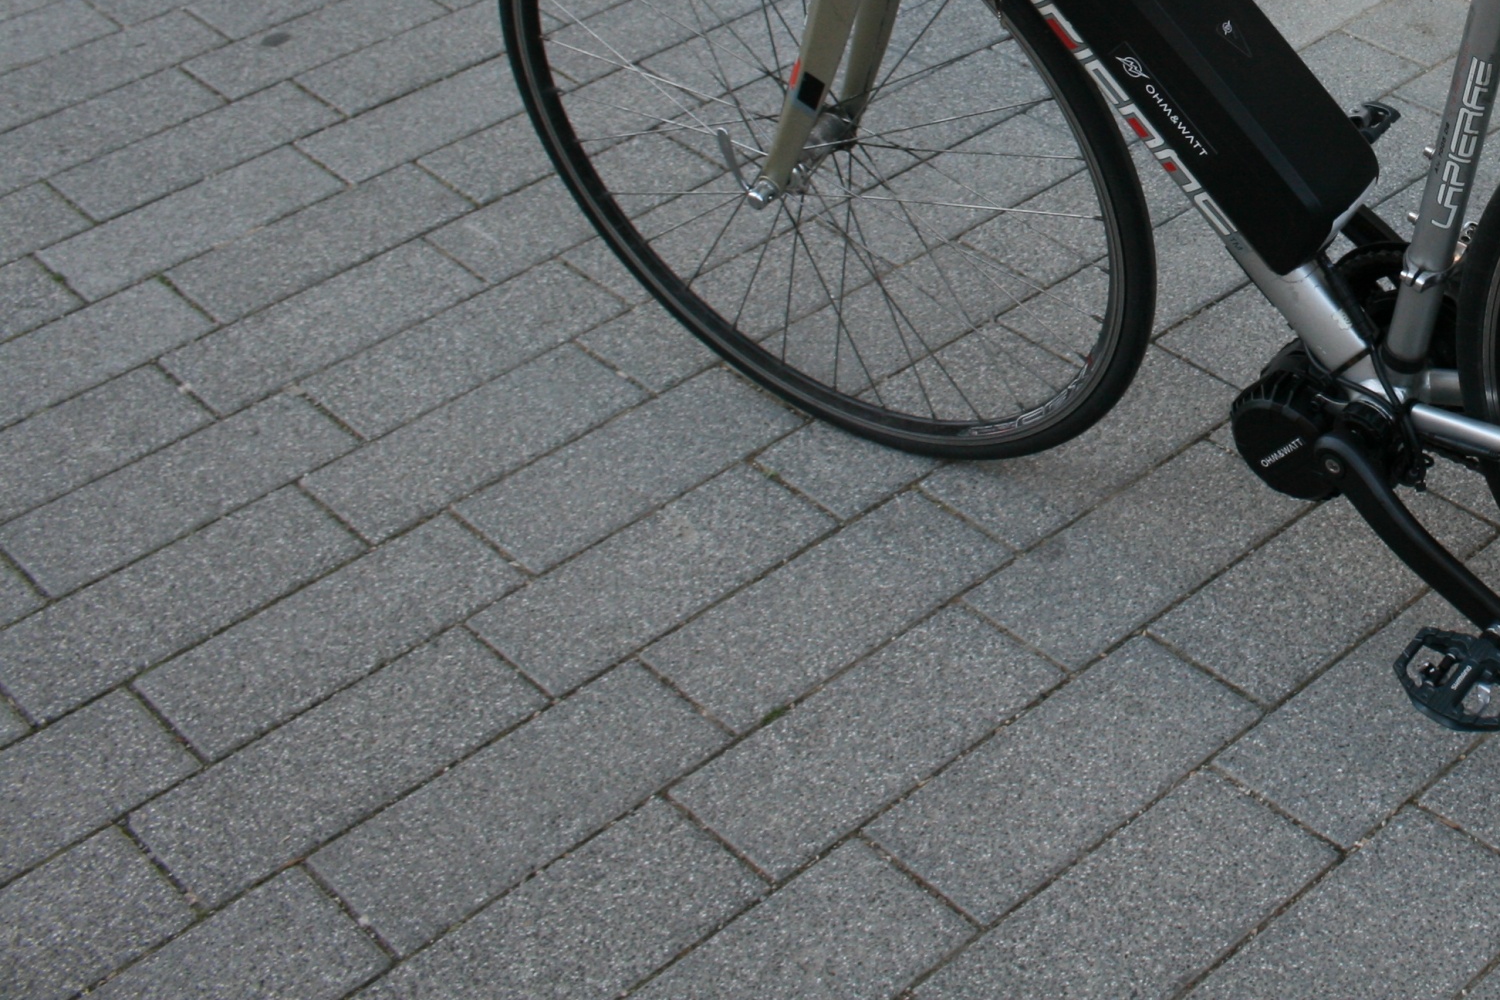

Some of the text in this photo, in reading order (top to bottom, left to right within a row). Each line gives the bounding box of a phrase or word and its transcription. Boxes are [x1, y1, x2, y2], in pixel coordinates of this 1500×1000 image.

[1145, 84, 1209, 157] OHM&WATT
[1431, 56, 1493, 229] LAPIERRE
[1260, 437, 1303, 468] OHM&WATT
